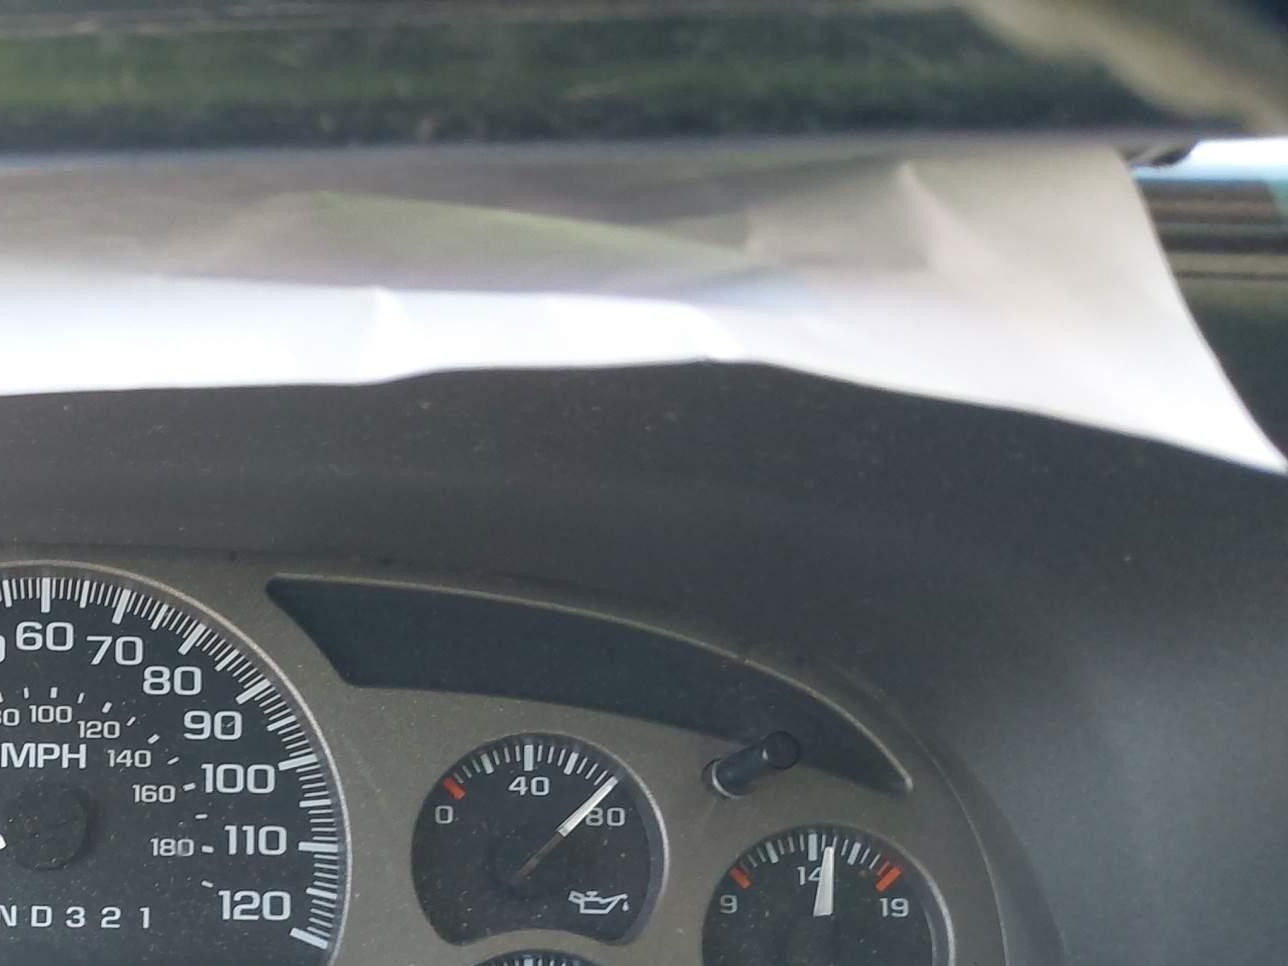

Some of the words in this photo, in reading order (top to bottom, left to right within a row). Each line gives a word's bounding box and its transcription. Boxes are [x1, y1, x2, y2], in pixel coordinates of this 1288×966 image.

[15, 621, 74, 651] 60
[86, 635, 143, 666] 70
[143, 665, 202, 696] 80
[29, 705, 73, 723] 100
[77, 720, 120, 739] 120
[183, 710, 242, 740] 90
[0, 742, 87, 769] MPH
[107, 749, 152, 768] 140
[201, 763, 275, 794] 100
[508, 776, 550, 796] 40
[132, 784, 176, 803] 160
[435, 805, 454, 825] 0
[585, 807, 626, 828] 80
[150, 838, 195, 857] 180
[224, 825, 287, 856] 110
[218, 890, 291, 921] 120
[720, 894, 738, 914] 9
[879, 897, 909, 918] 19
[30, 905, 53, 927] D
[65, 906, 86, 928] 3
[100, 906, 121, 929] 2
[139, 907, 150, 929] 1
